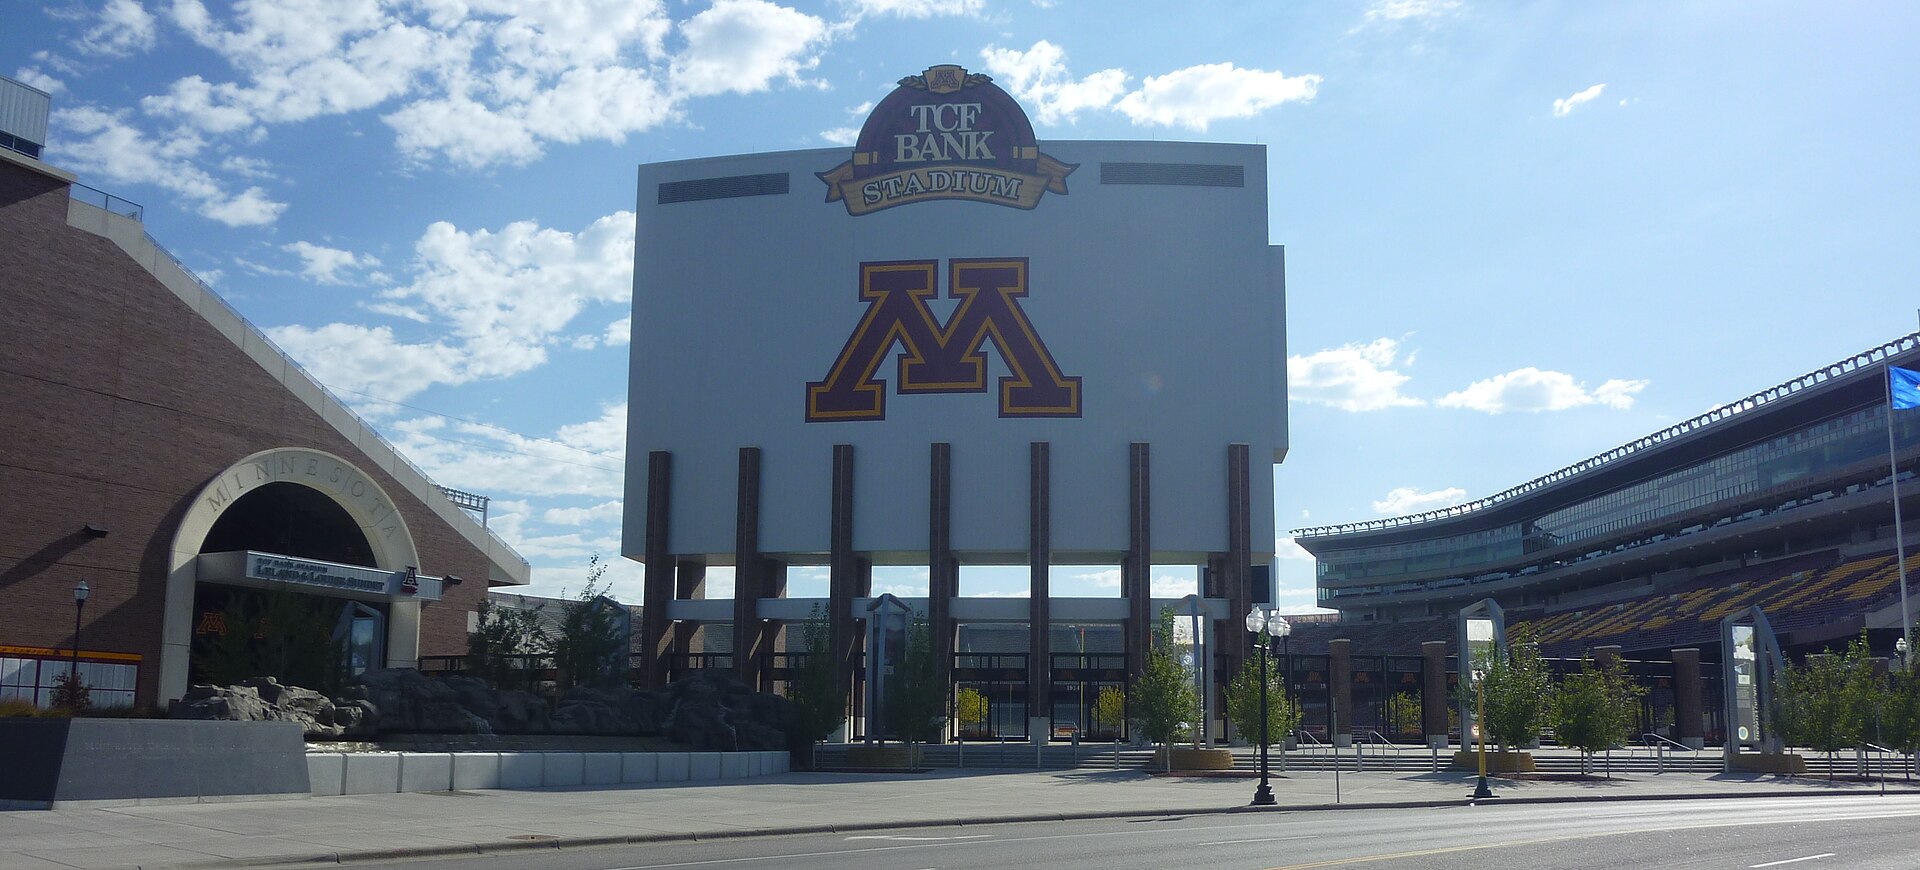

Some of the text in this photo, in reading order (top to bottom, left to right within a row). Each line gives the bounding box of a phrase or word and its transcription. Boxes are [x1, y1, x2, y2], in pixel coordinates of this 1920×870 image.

[910, 103, 981, 133] TCF
[893, 131, 996, 163] BANK
[862, 170, 1024, 206] STADIUM
[805, 256, 1083, 423] M
[207, 456, 396, 538] MINNESOTA
